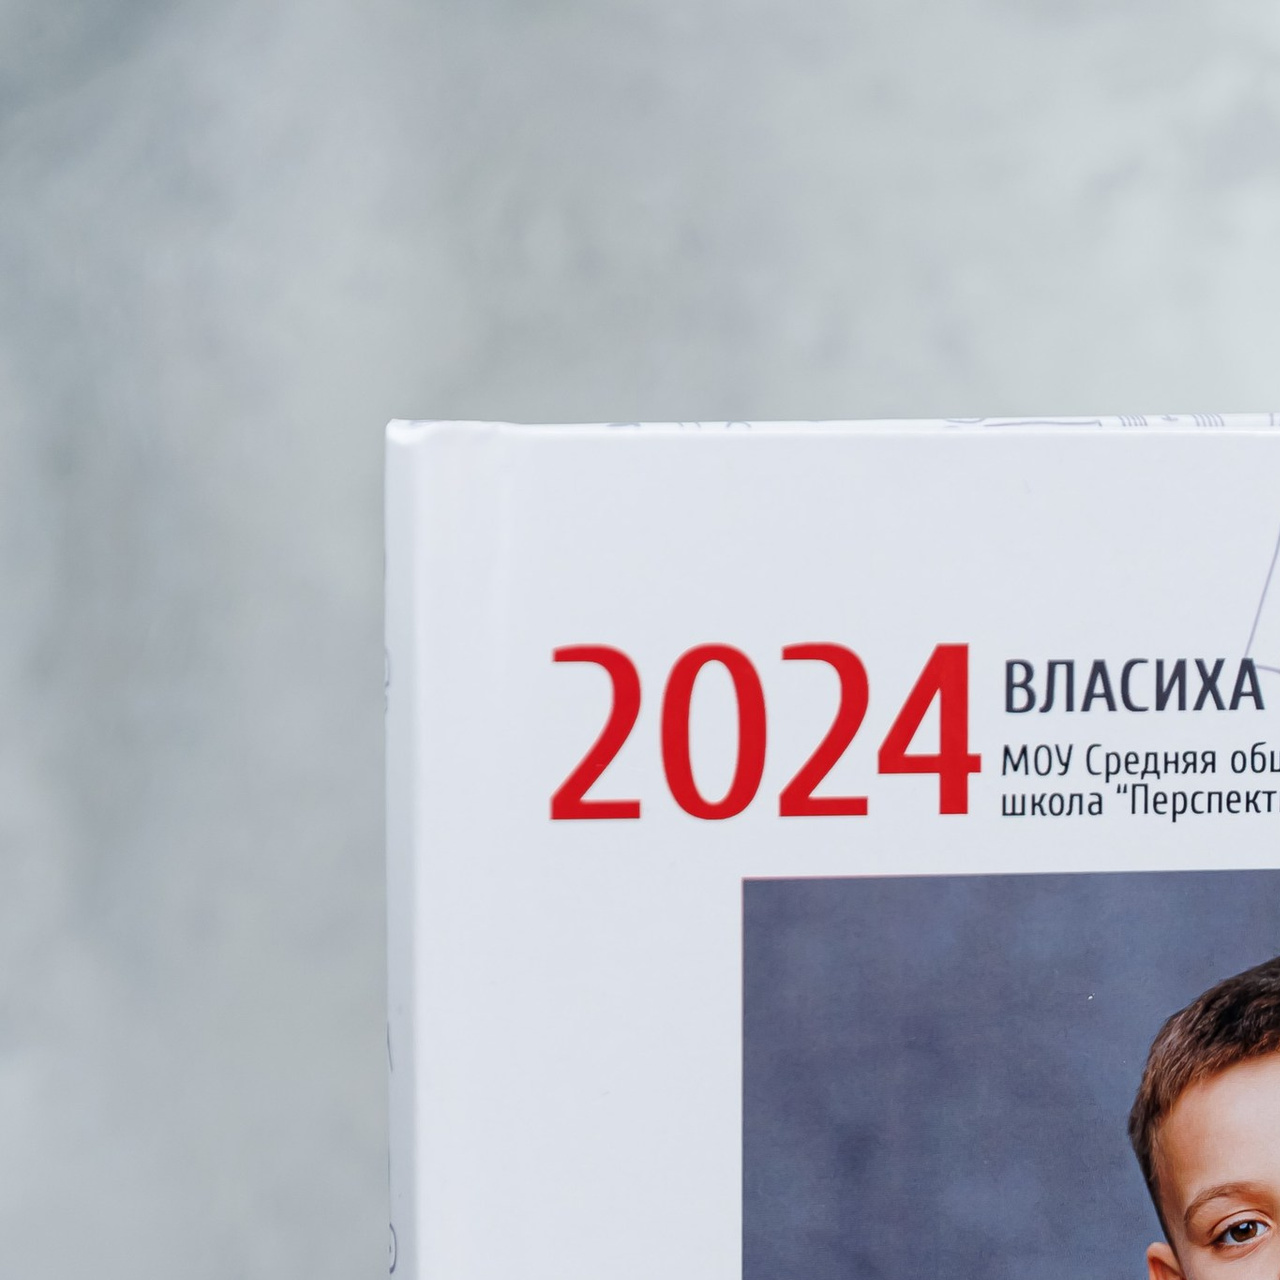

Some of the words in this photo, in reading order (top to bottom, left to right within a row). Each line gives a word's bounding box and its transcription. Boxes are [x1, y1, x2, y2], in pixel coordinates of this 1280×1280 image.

[1005, 658, 1266, 713] ВЛАСИХА
[550, 642, 982, 821] 2024
[1002, 744, 1073, 776] МОУ
[1086, 743, 1217, 783] Средняя
[1001, 792, 1103, 817] школа
